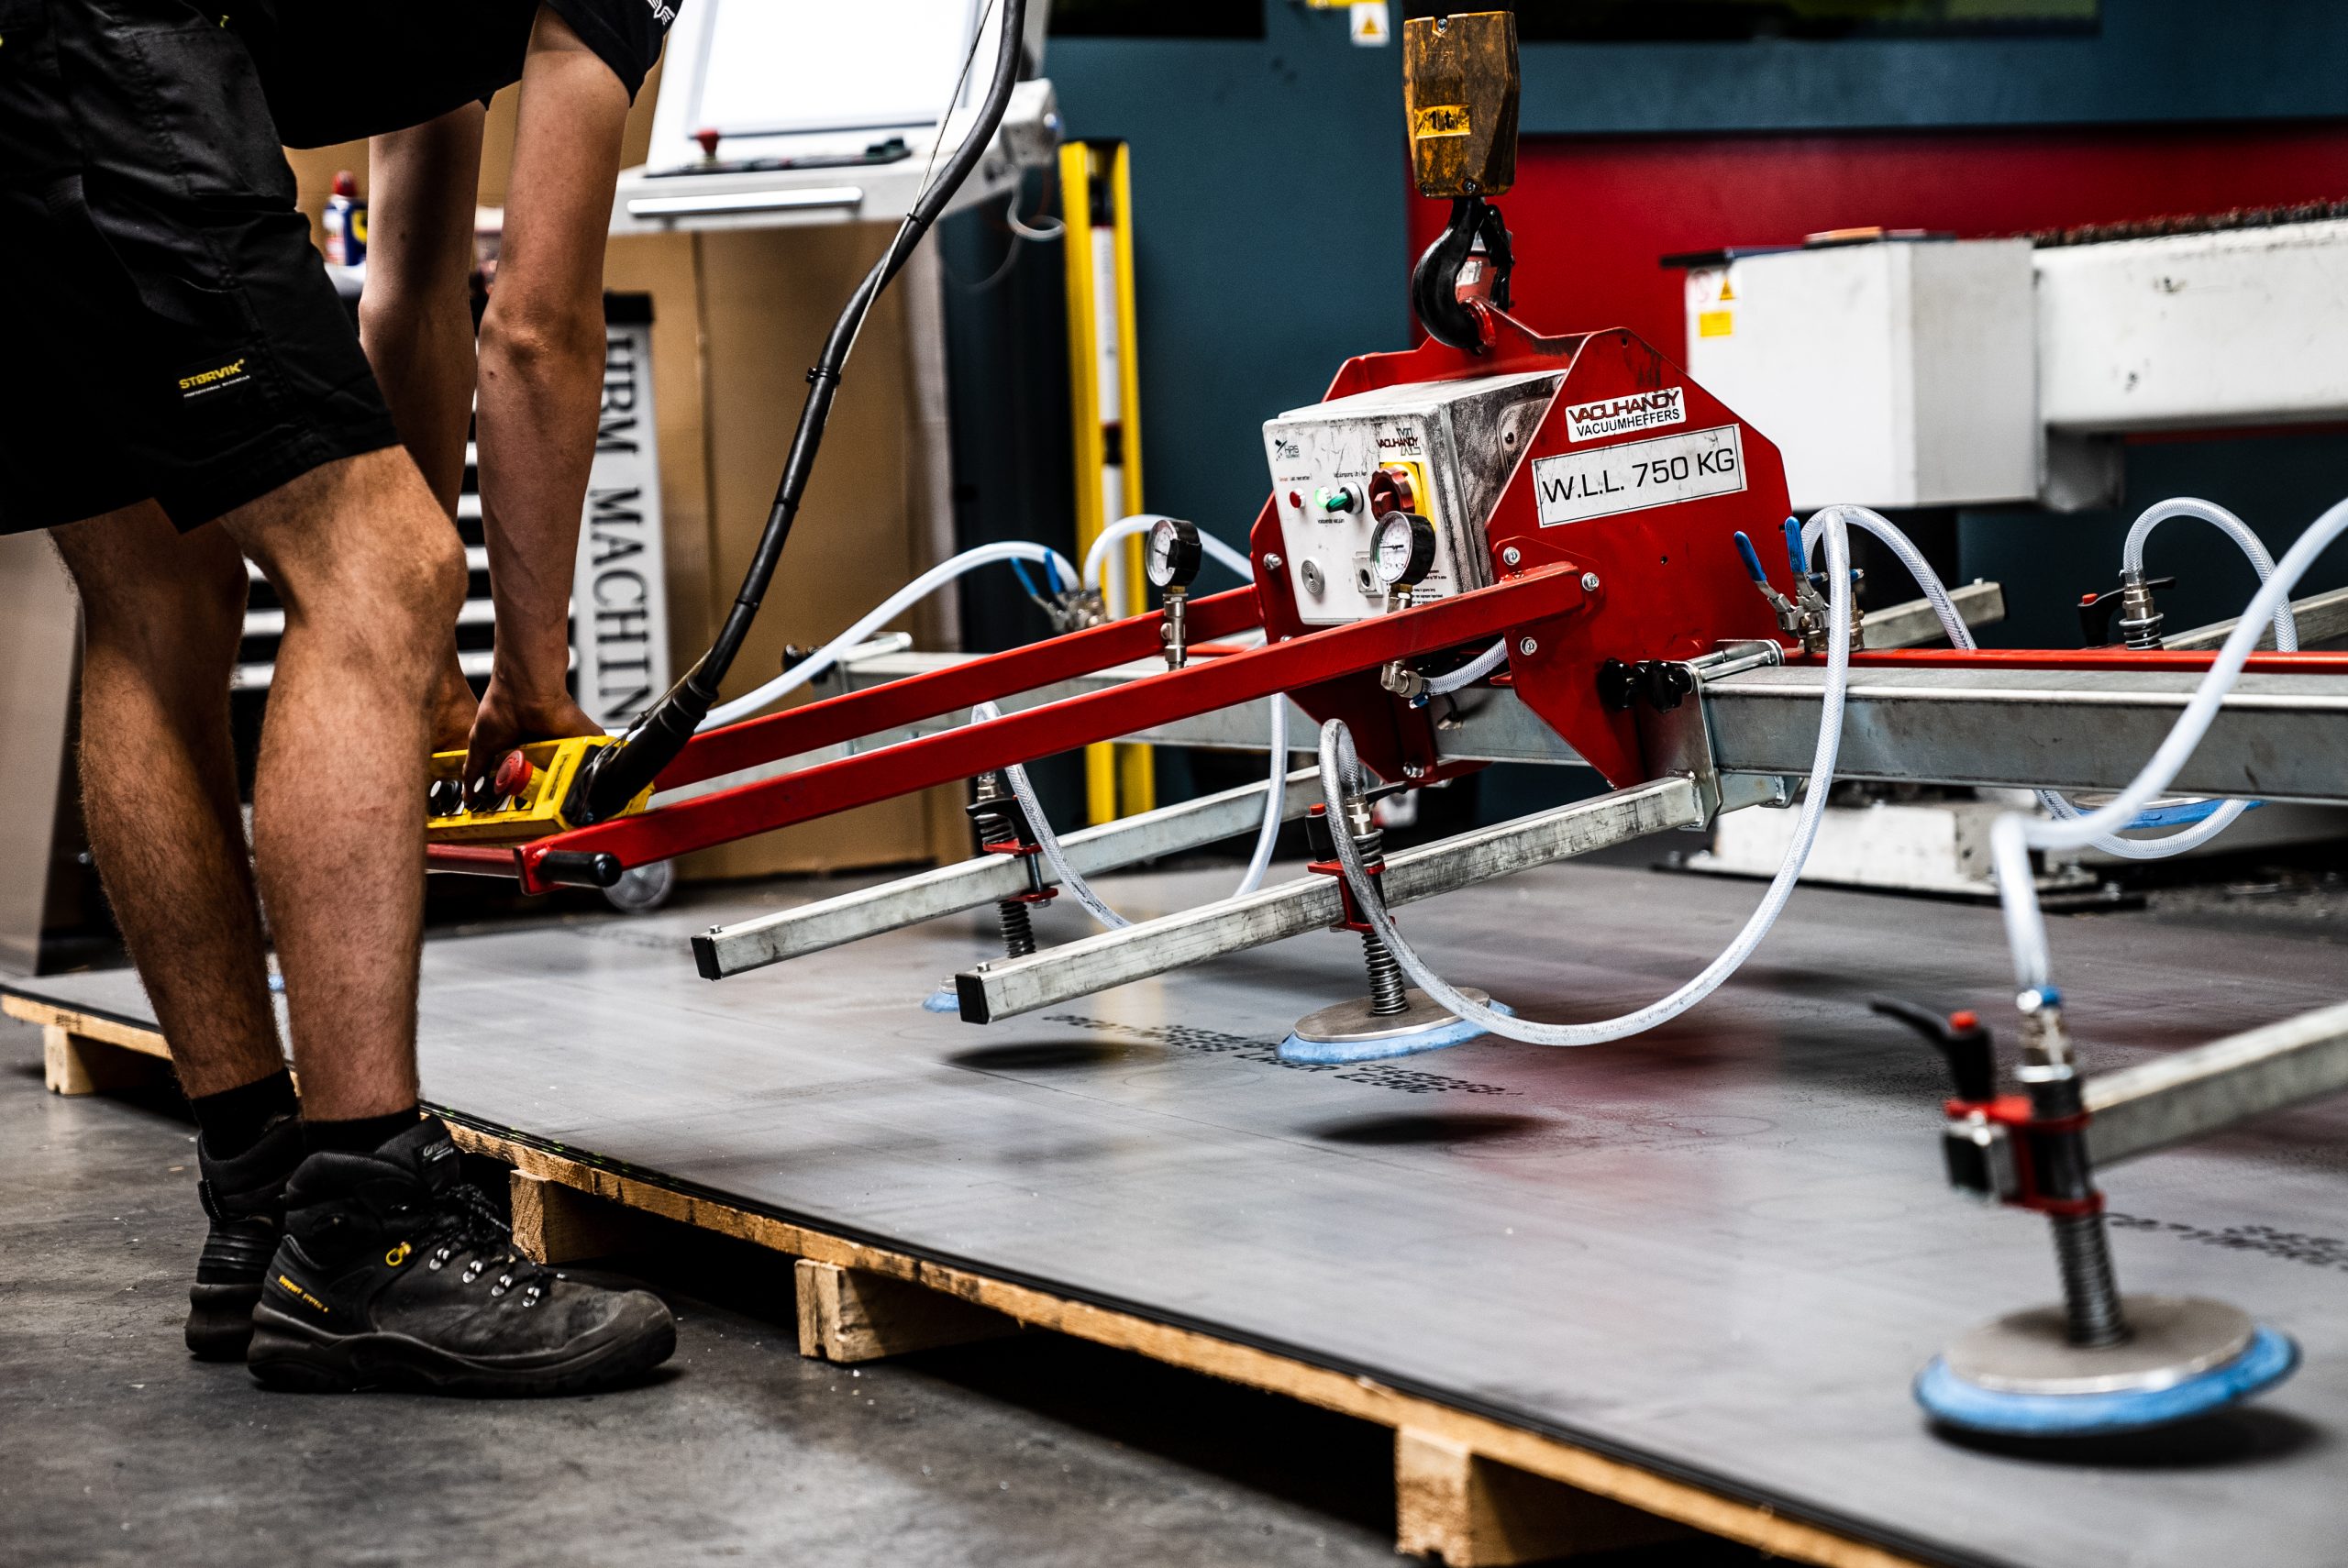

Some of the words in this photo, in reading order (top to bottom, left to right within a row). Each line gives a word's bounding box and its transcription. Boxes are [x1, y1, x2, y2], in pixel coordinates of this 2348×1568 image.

[1567, 390, 1679, 424] VACUHANDY
[1576, 407, 1680, 437] VACUÜMHEFFERS
[1542, 469, 1624, 503] W.L.L.
[1632, 456, 1689, 488] 750
[1697, 447, 1735, 476] KG
